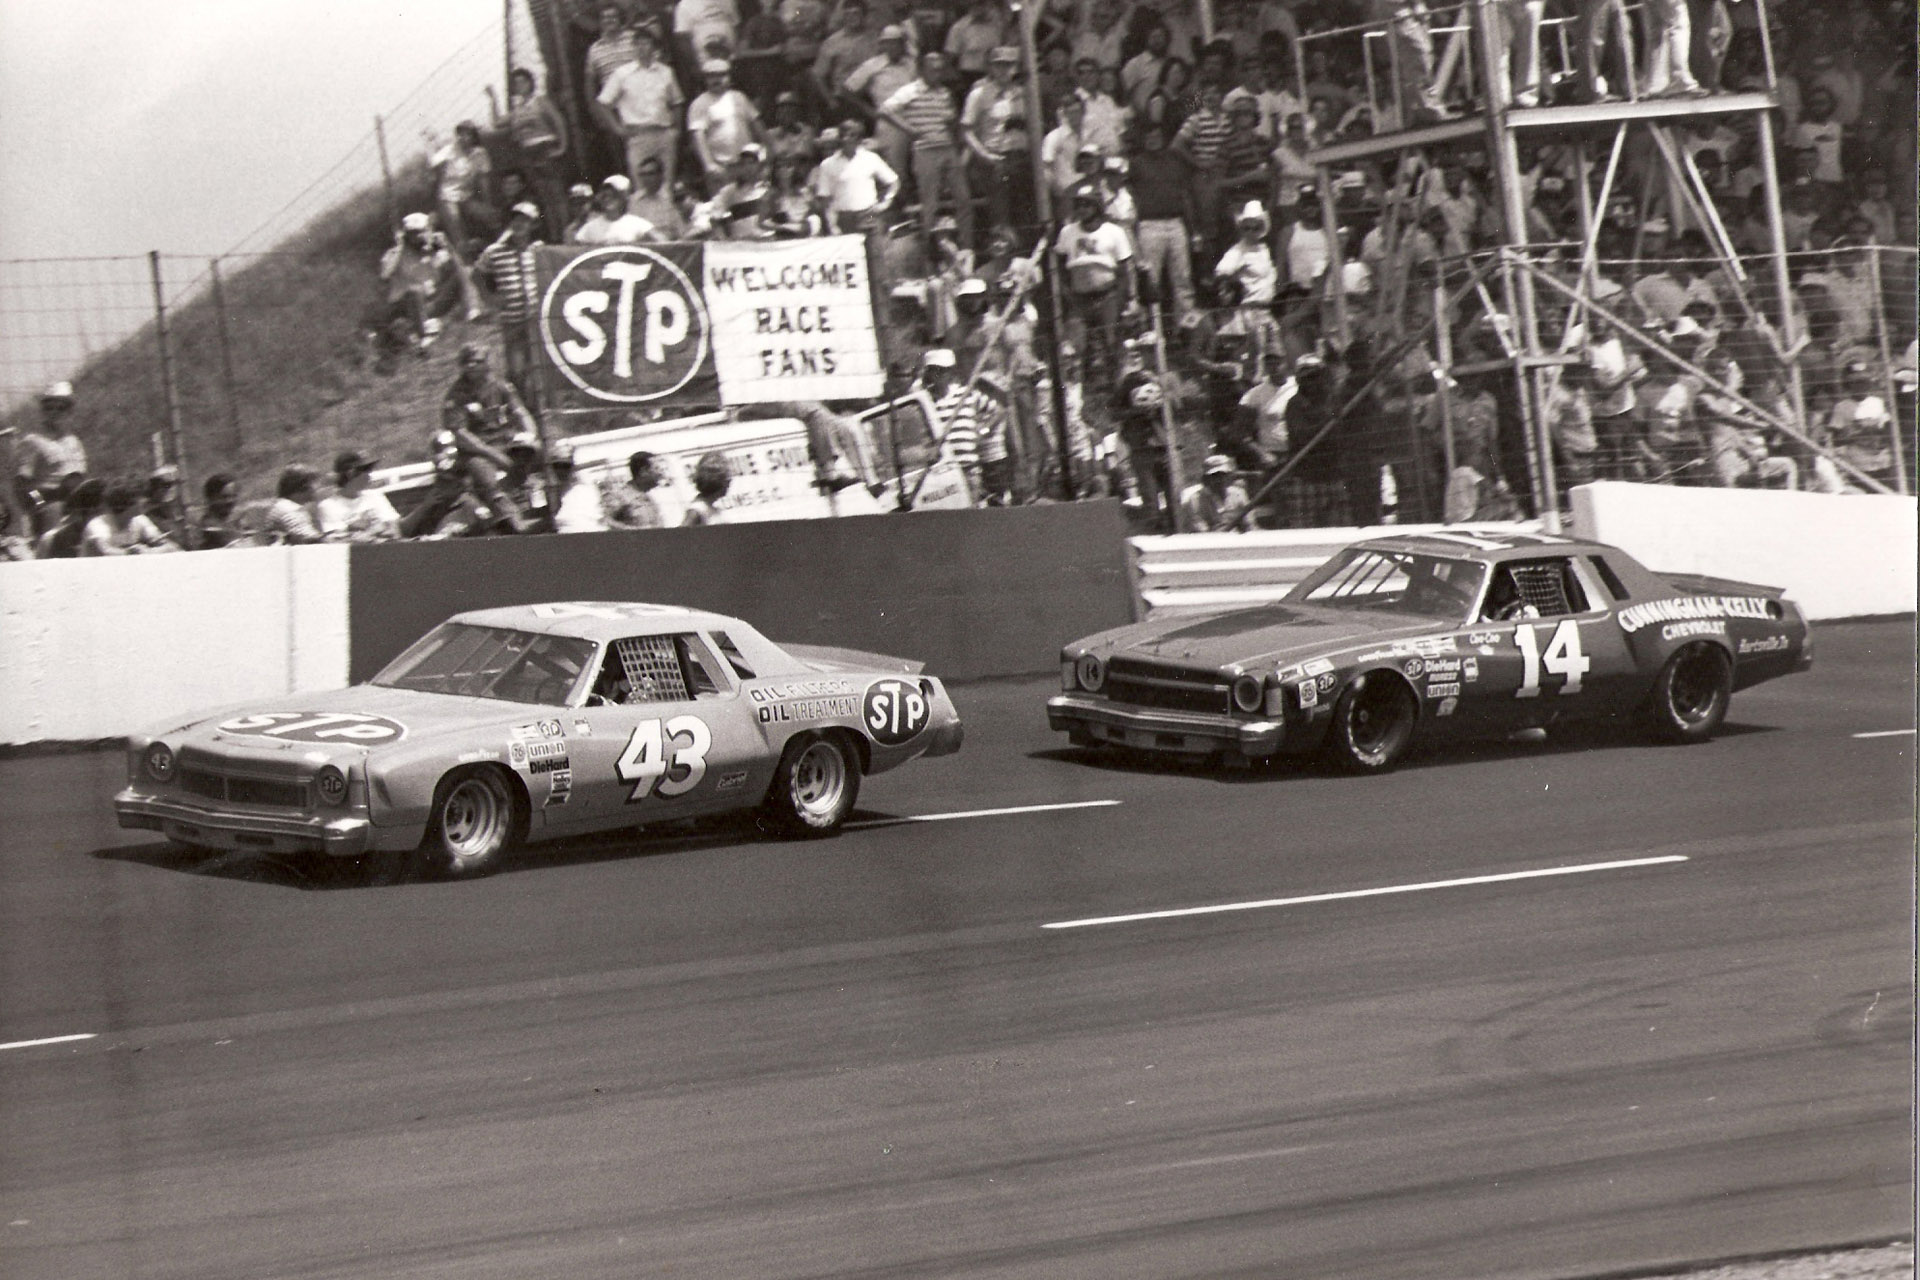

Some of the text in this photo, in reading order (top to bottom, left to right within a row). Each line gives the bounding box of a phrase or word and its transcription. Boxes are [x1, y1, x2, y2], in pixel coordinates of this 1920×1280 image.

[710, 262, 858, 292] WELCOME
[559, 261, 690, 378] STP
[756, 306, 832, 334] RACE
[762, 348, 837, 376] FANS
[1618, 596, 1776, 632] CUNNINGHAM-KELLY
[1662, 620, 1726, 640] CHEVROLET
[1407, 660, 1422, 676] STP
[1513, 619, 1590, 698] 14
[1086, 663, 1099, 681] 14
[1318, 674, 1335, 690] STP
[750, 687, 786, 702] OIL
[758, 697, 860, 722] OIL TREATMENT
[870, 682, 924, 734] STP
[217, 712, 396, 738] STP
[151, 752, 170, 770] 43
[529, 757, 570, 774] DieHard
[616, 714, 713, 801] 43
[322, 779, 343, 794] STP
